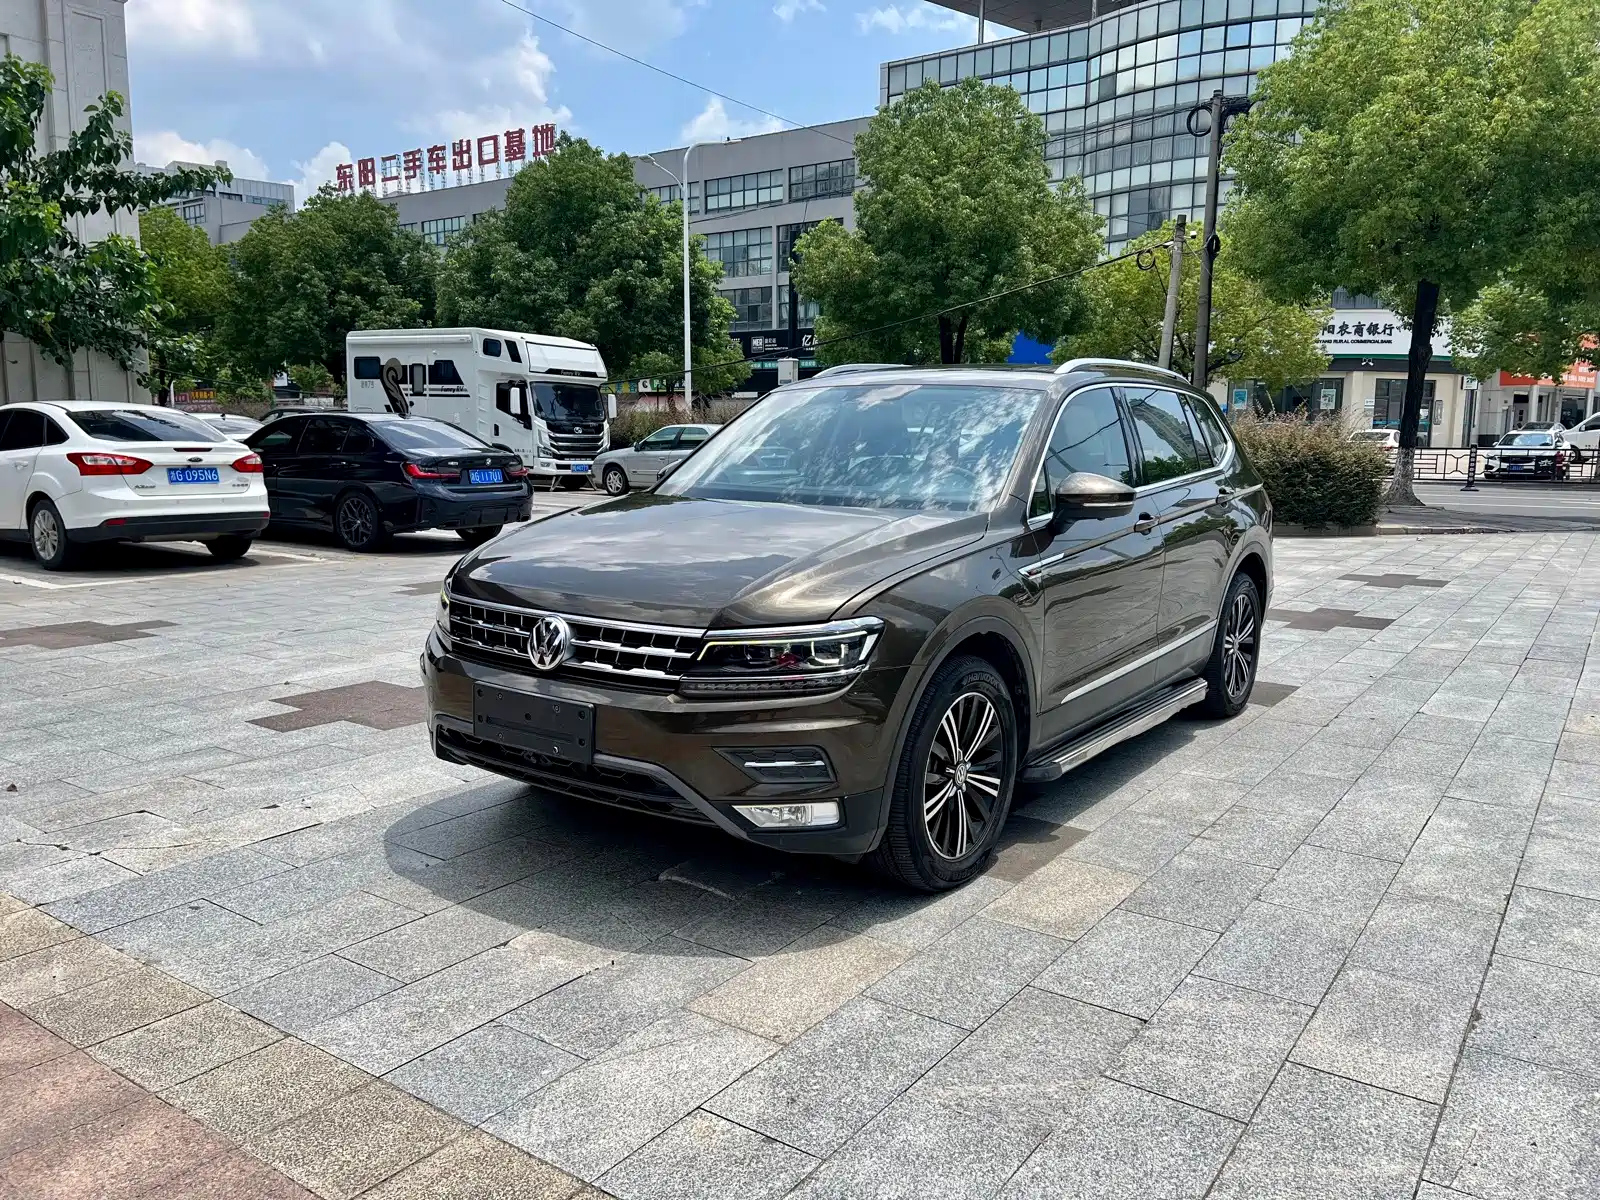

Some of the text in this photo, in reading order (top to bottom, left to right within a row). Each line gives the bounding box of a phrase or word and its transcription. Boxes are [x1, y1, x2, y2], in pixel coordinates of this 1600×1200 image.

[336, 124, 556, 191] 东阳二手车出口基地
